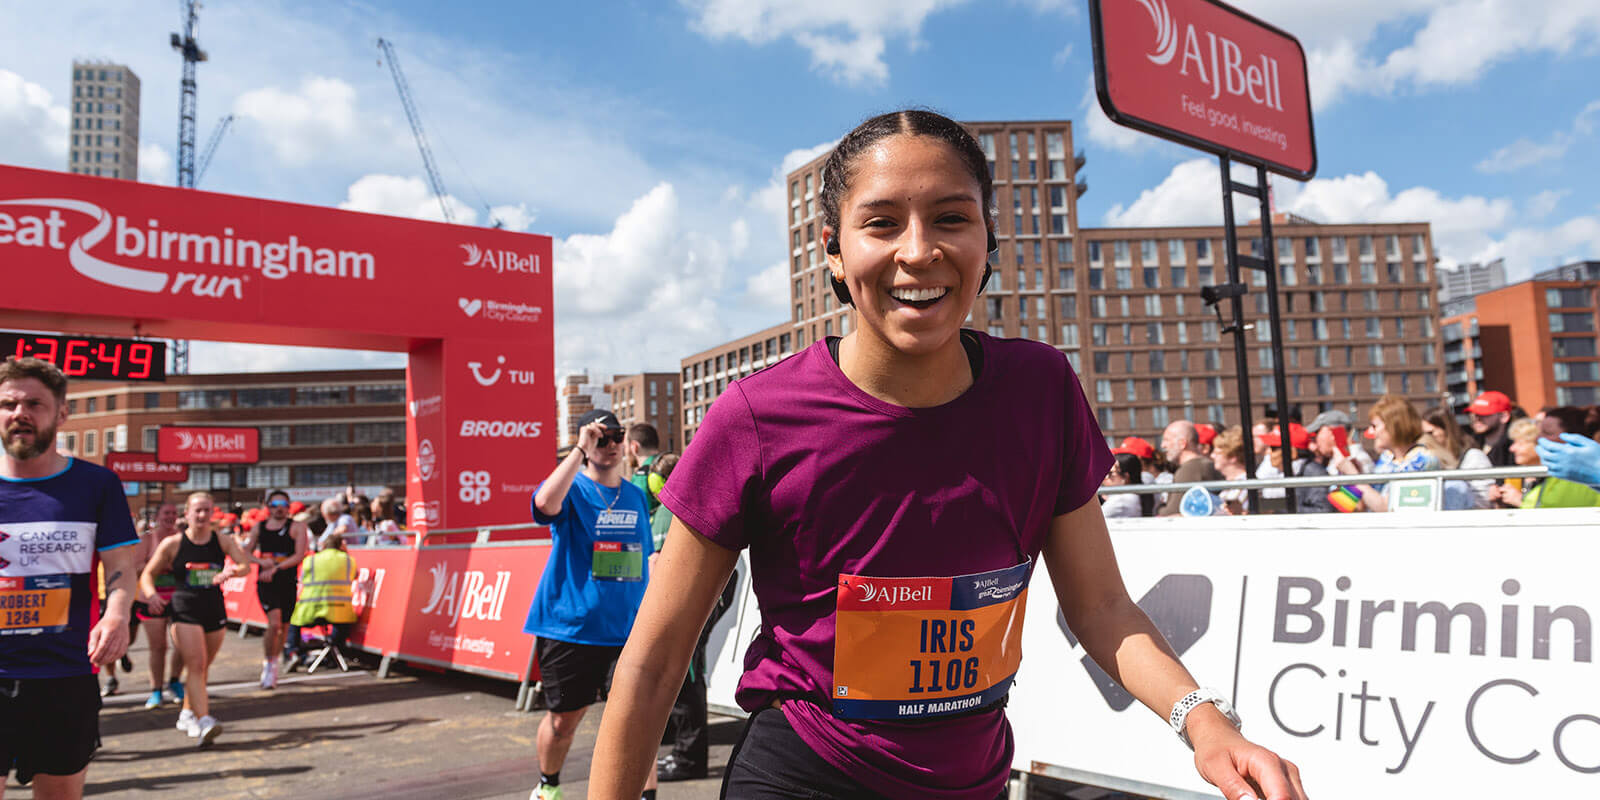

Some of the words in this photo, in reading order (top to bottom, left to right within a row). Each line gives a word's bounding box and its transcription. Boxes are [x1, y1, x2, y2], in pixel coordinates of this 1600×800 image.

[1180, 24, 1284, 111] AJBell
[1181, 95, 1206, 120] Feel
[116, 216, 375, 280] birmingham
[481, 249, 541, 274] AJBell
[488, 300, 542, 314] Birmingham
[508, 370, 534, 384] TUI
[460, 420, 542, 437] BROOKS
[192, 434, 245, 452] AJBell
[113, 462, 182, 473] NISSAN
[19, 530, 79, 541] CANCER
[19, 542, 87, 554] RESEARCH
[19, 556, 40, 567] UK
[0, 594, 48, 609] ROBERT
[435, 571, 512, 629] AJBell
[876, 586, 932, 605] AJBell
[5, 610, 39, 626] 1264
[1272, 576, 1592, 663] Birmin
[920, 619, 975, 654] IRIS
[909, 657, 979, 693] 1106
[898, 705, 924, 715] HALF
[927, 695, 982, 713] MARATHON
[1269, 663, 1436, 774] City
[1464, 679, 1600, 774] Co
